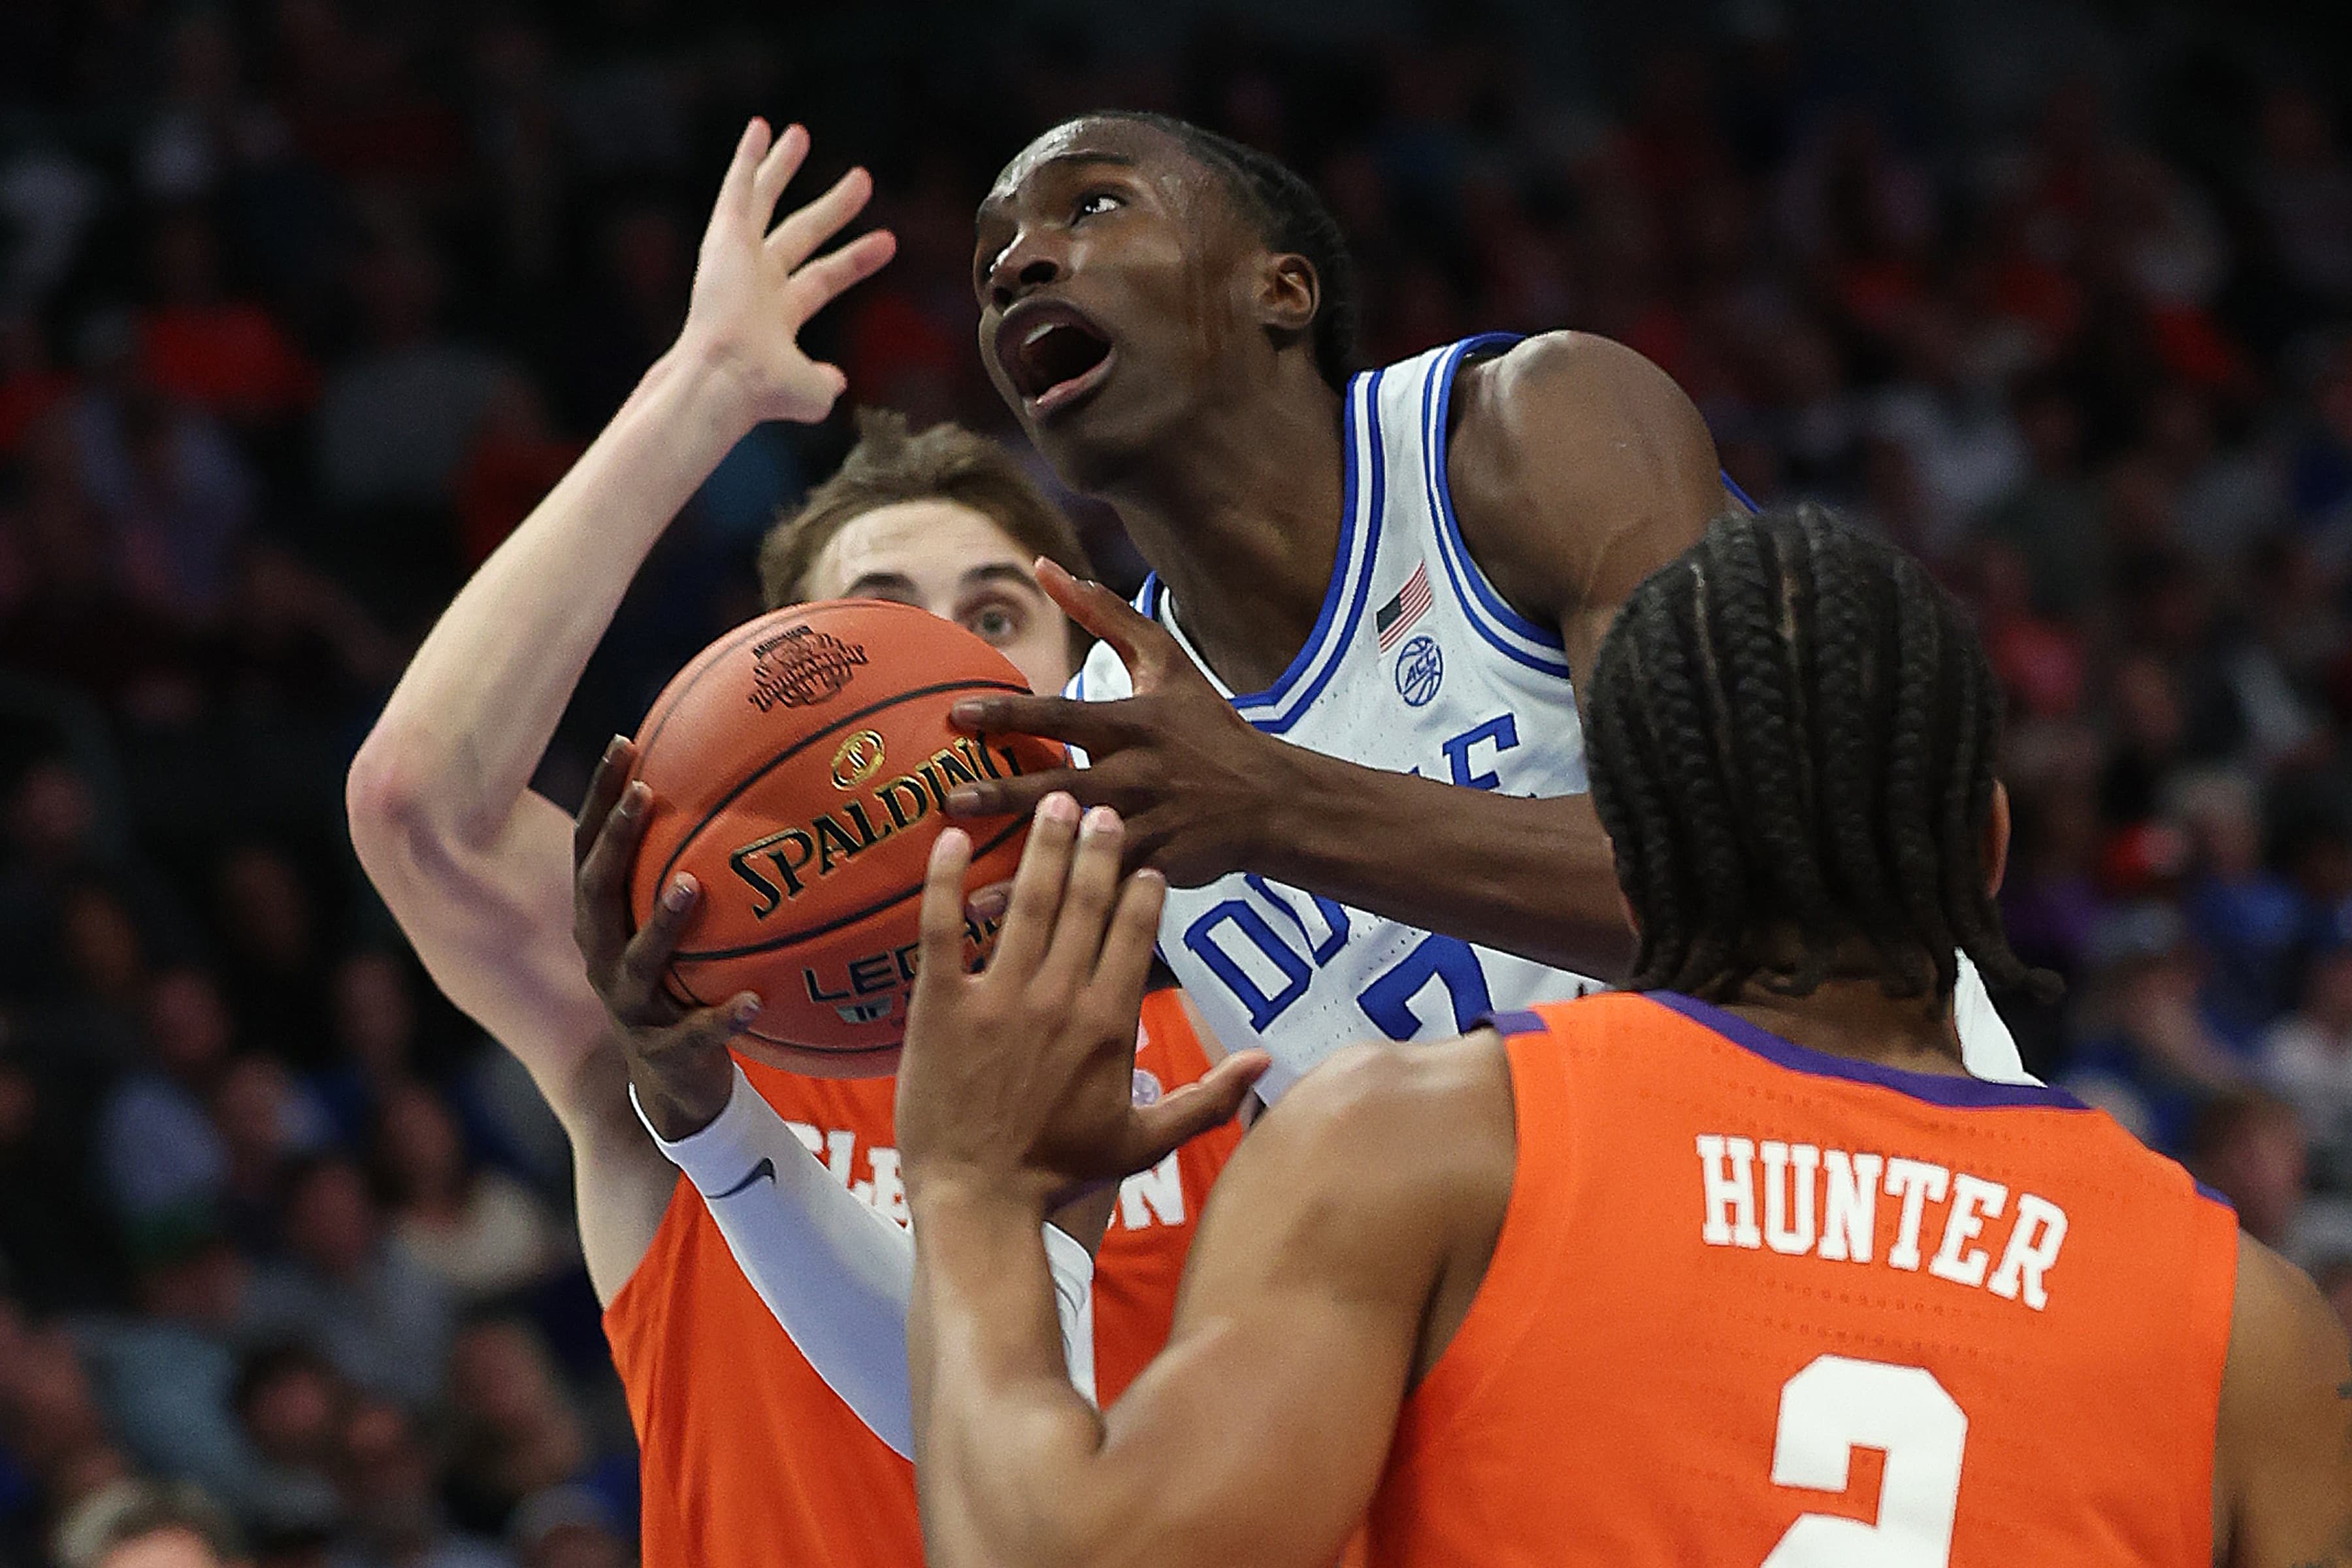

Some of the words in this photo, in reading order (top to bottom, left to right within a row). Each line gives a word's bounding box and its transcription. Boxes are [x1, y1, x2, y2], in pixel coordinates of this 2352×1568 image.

[1183, 712, 1520, 1034] DUE
[1696, 1134, 2068, 1311] HUNTER
[1760, 1352, 1968, 1568] 2
